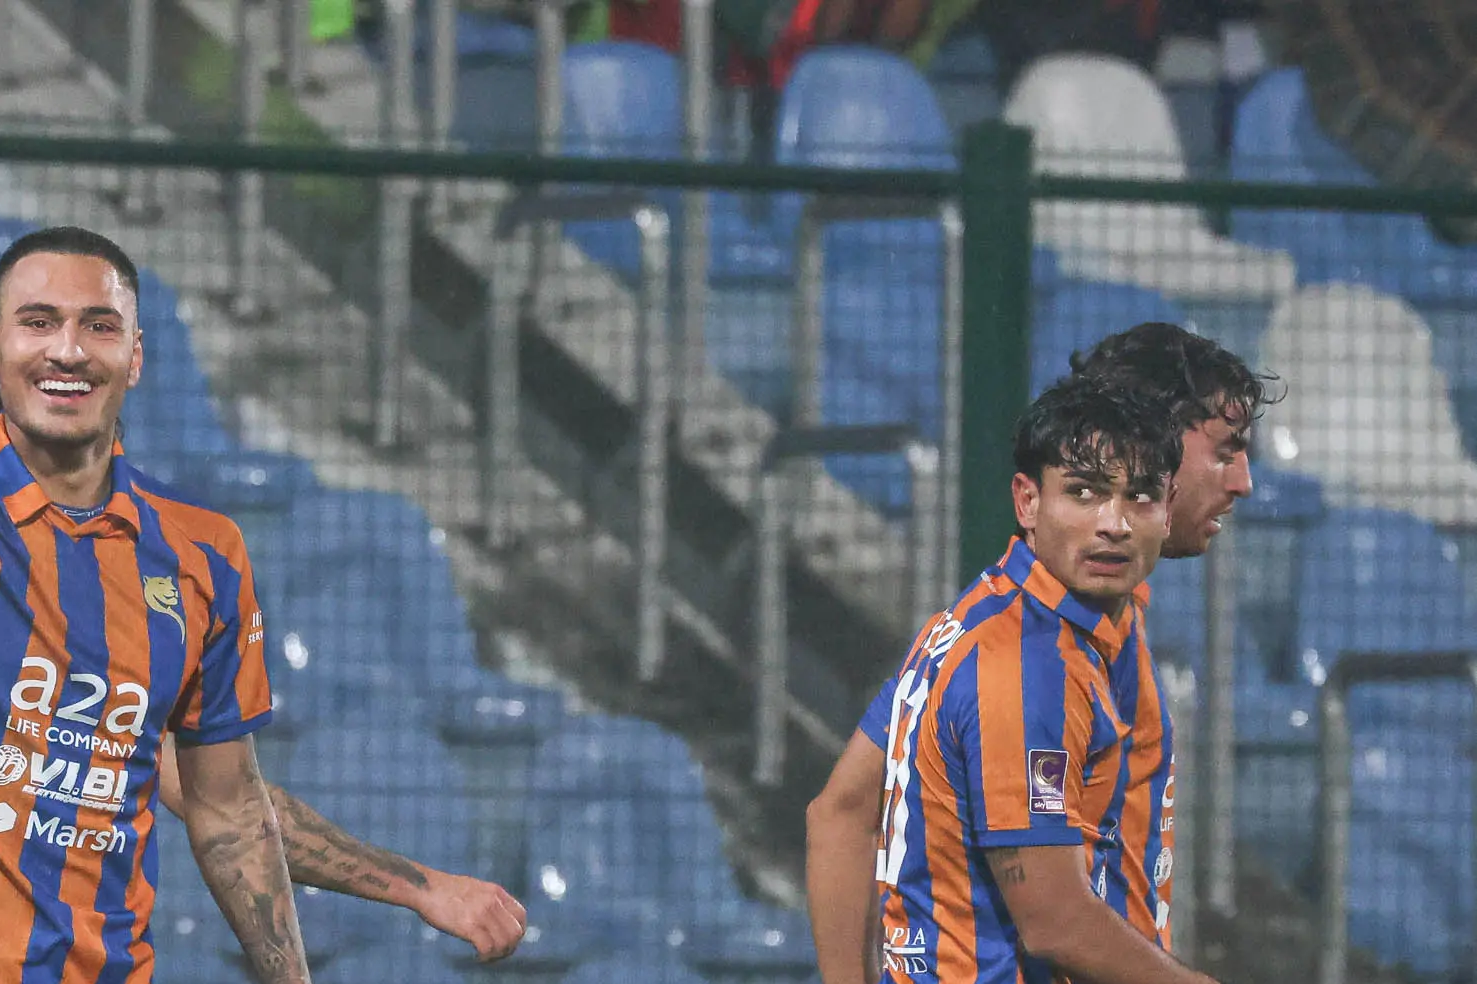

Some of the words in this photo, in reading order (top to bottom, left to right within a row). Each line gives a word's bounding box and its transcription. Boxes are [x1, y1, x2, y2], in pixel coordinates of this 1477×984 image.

[9, 656, 149, 737] a2a
[5, 715, 40, 738] LIFE
[45, 725, 138, 759] COMPANY
[23, 810, 127, 854] Marsh
